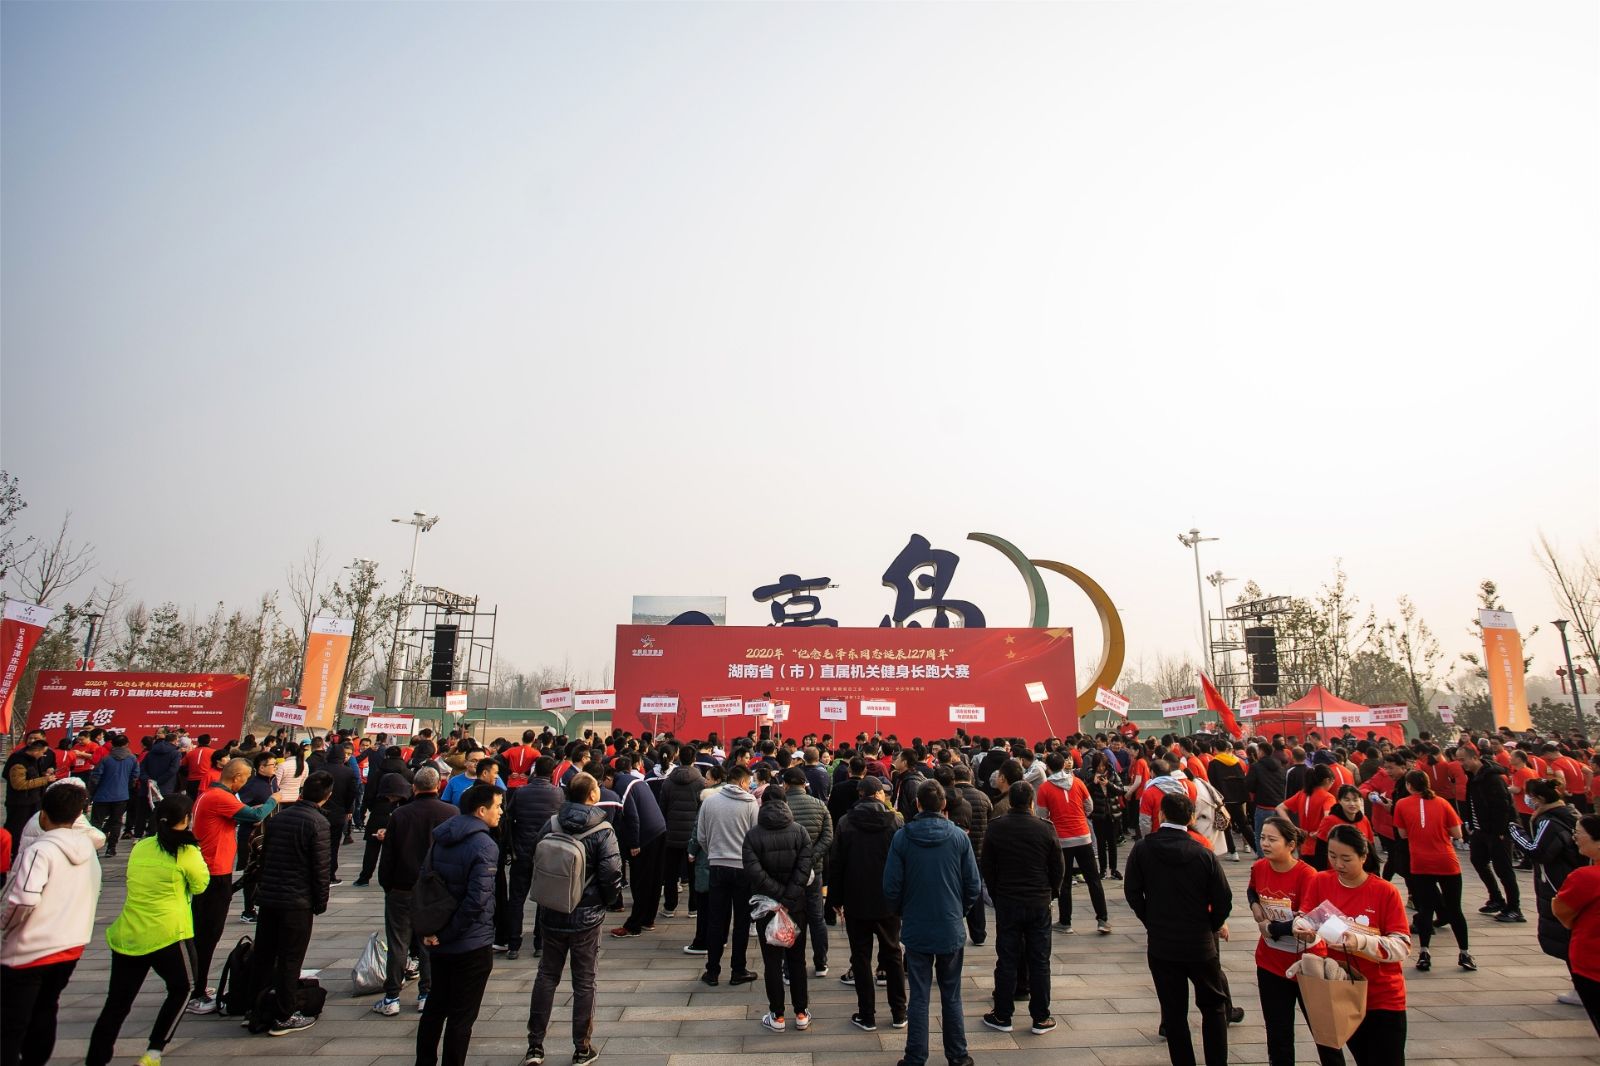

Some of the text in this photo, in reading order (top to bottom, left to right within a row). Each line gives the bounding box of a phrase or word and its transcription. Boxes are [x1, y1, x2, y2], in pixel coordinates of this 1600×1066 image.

[745, 648, 785, 661] 2020年
[728, 663, 970, 680] 湖南省（市）直属机关健身长跑大赛
[72, 688, 213, 698] 湖南省（市）直属机关健身长跑大赛
[39, 708, 115, 730] 恭喜您
[370, 721, 408, 731] 怀化市代表队
